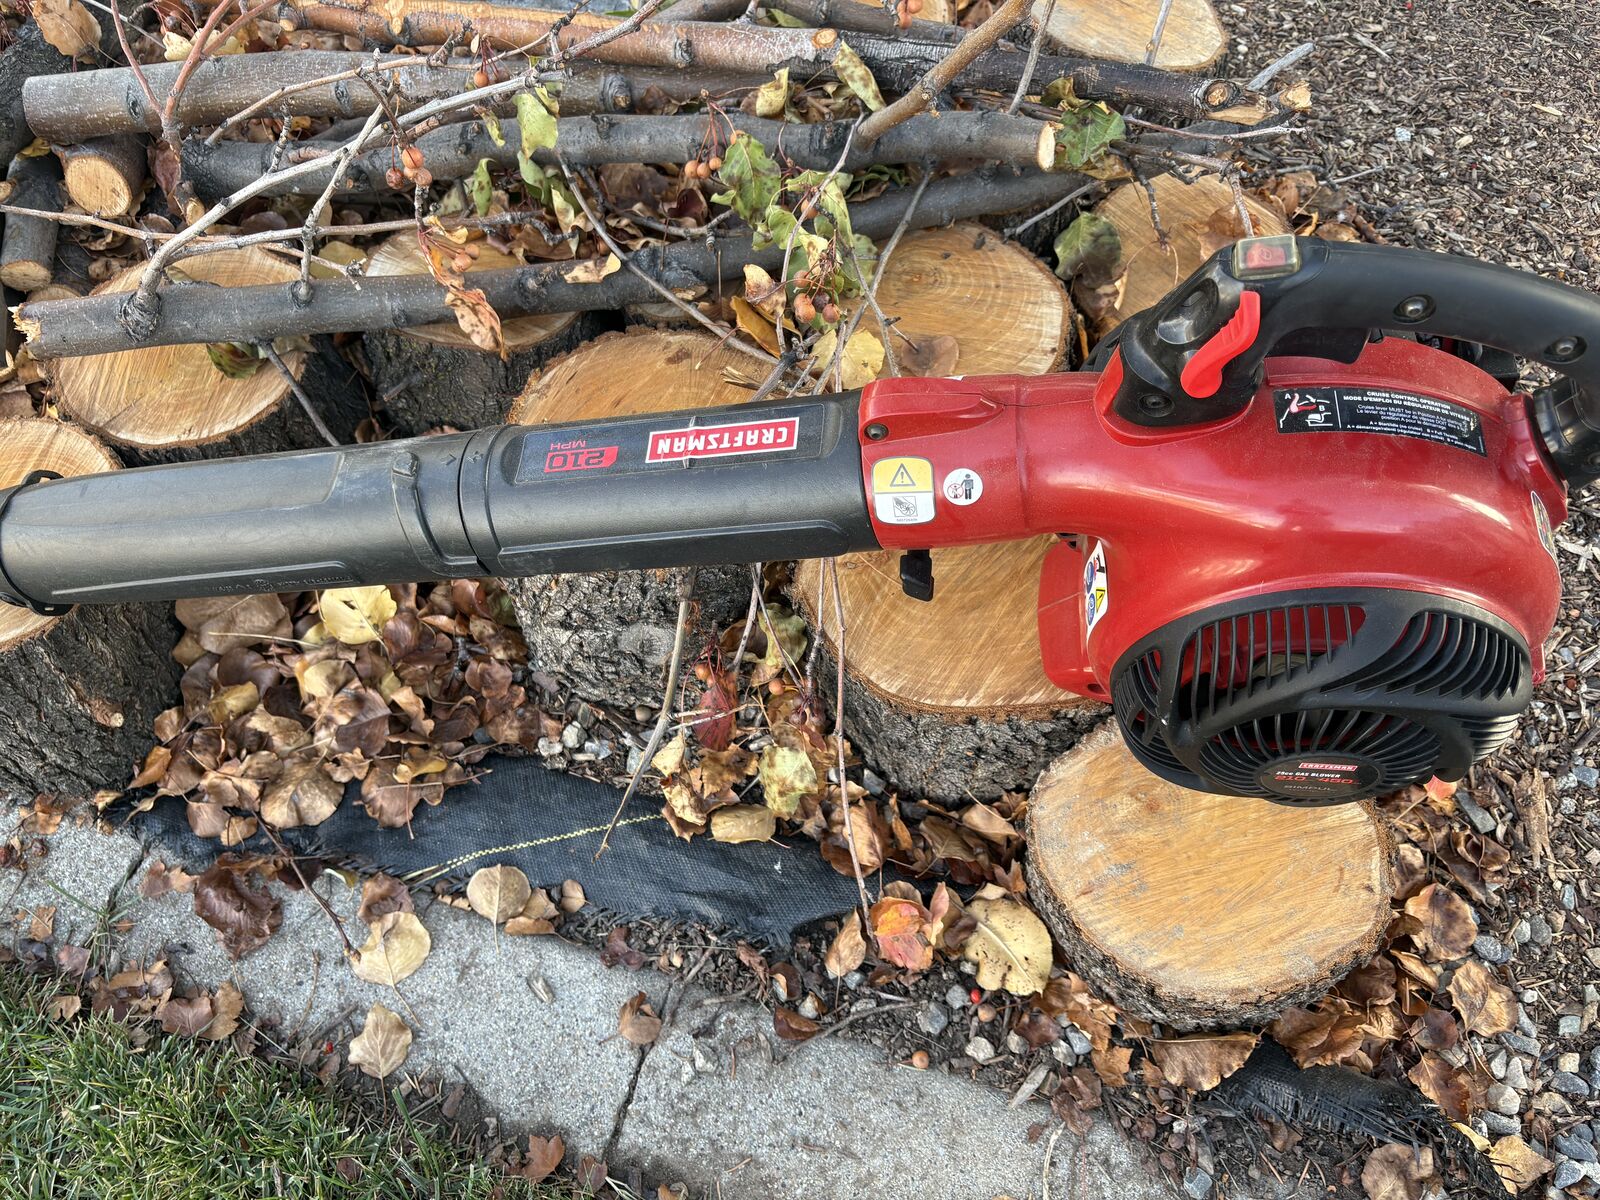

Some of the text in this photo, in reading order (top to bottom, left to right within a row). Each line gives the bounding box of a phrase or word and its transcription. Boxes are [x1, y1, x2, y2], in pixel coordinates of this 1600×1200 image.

[1363, 396, 1392, 404] D'EMPLOI
[1449, 411, 1470, 422] VITESSE
[1391, 392, 1419, 402] CONTROL
[1420, 398, 1450, 410] OPERATION
[550, 439, 586, 451] MPH
[658, 427, 788, 455] CRAFTSMAN
[549, 449, 605, 470] 210
